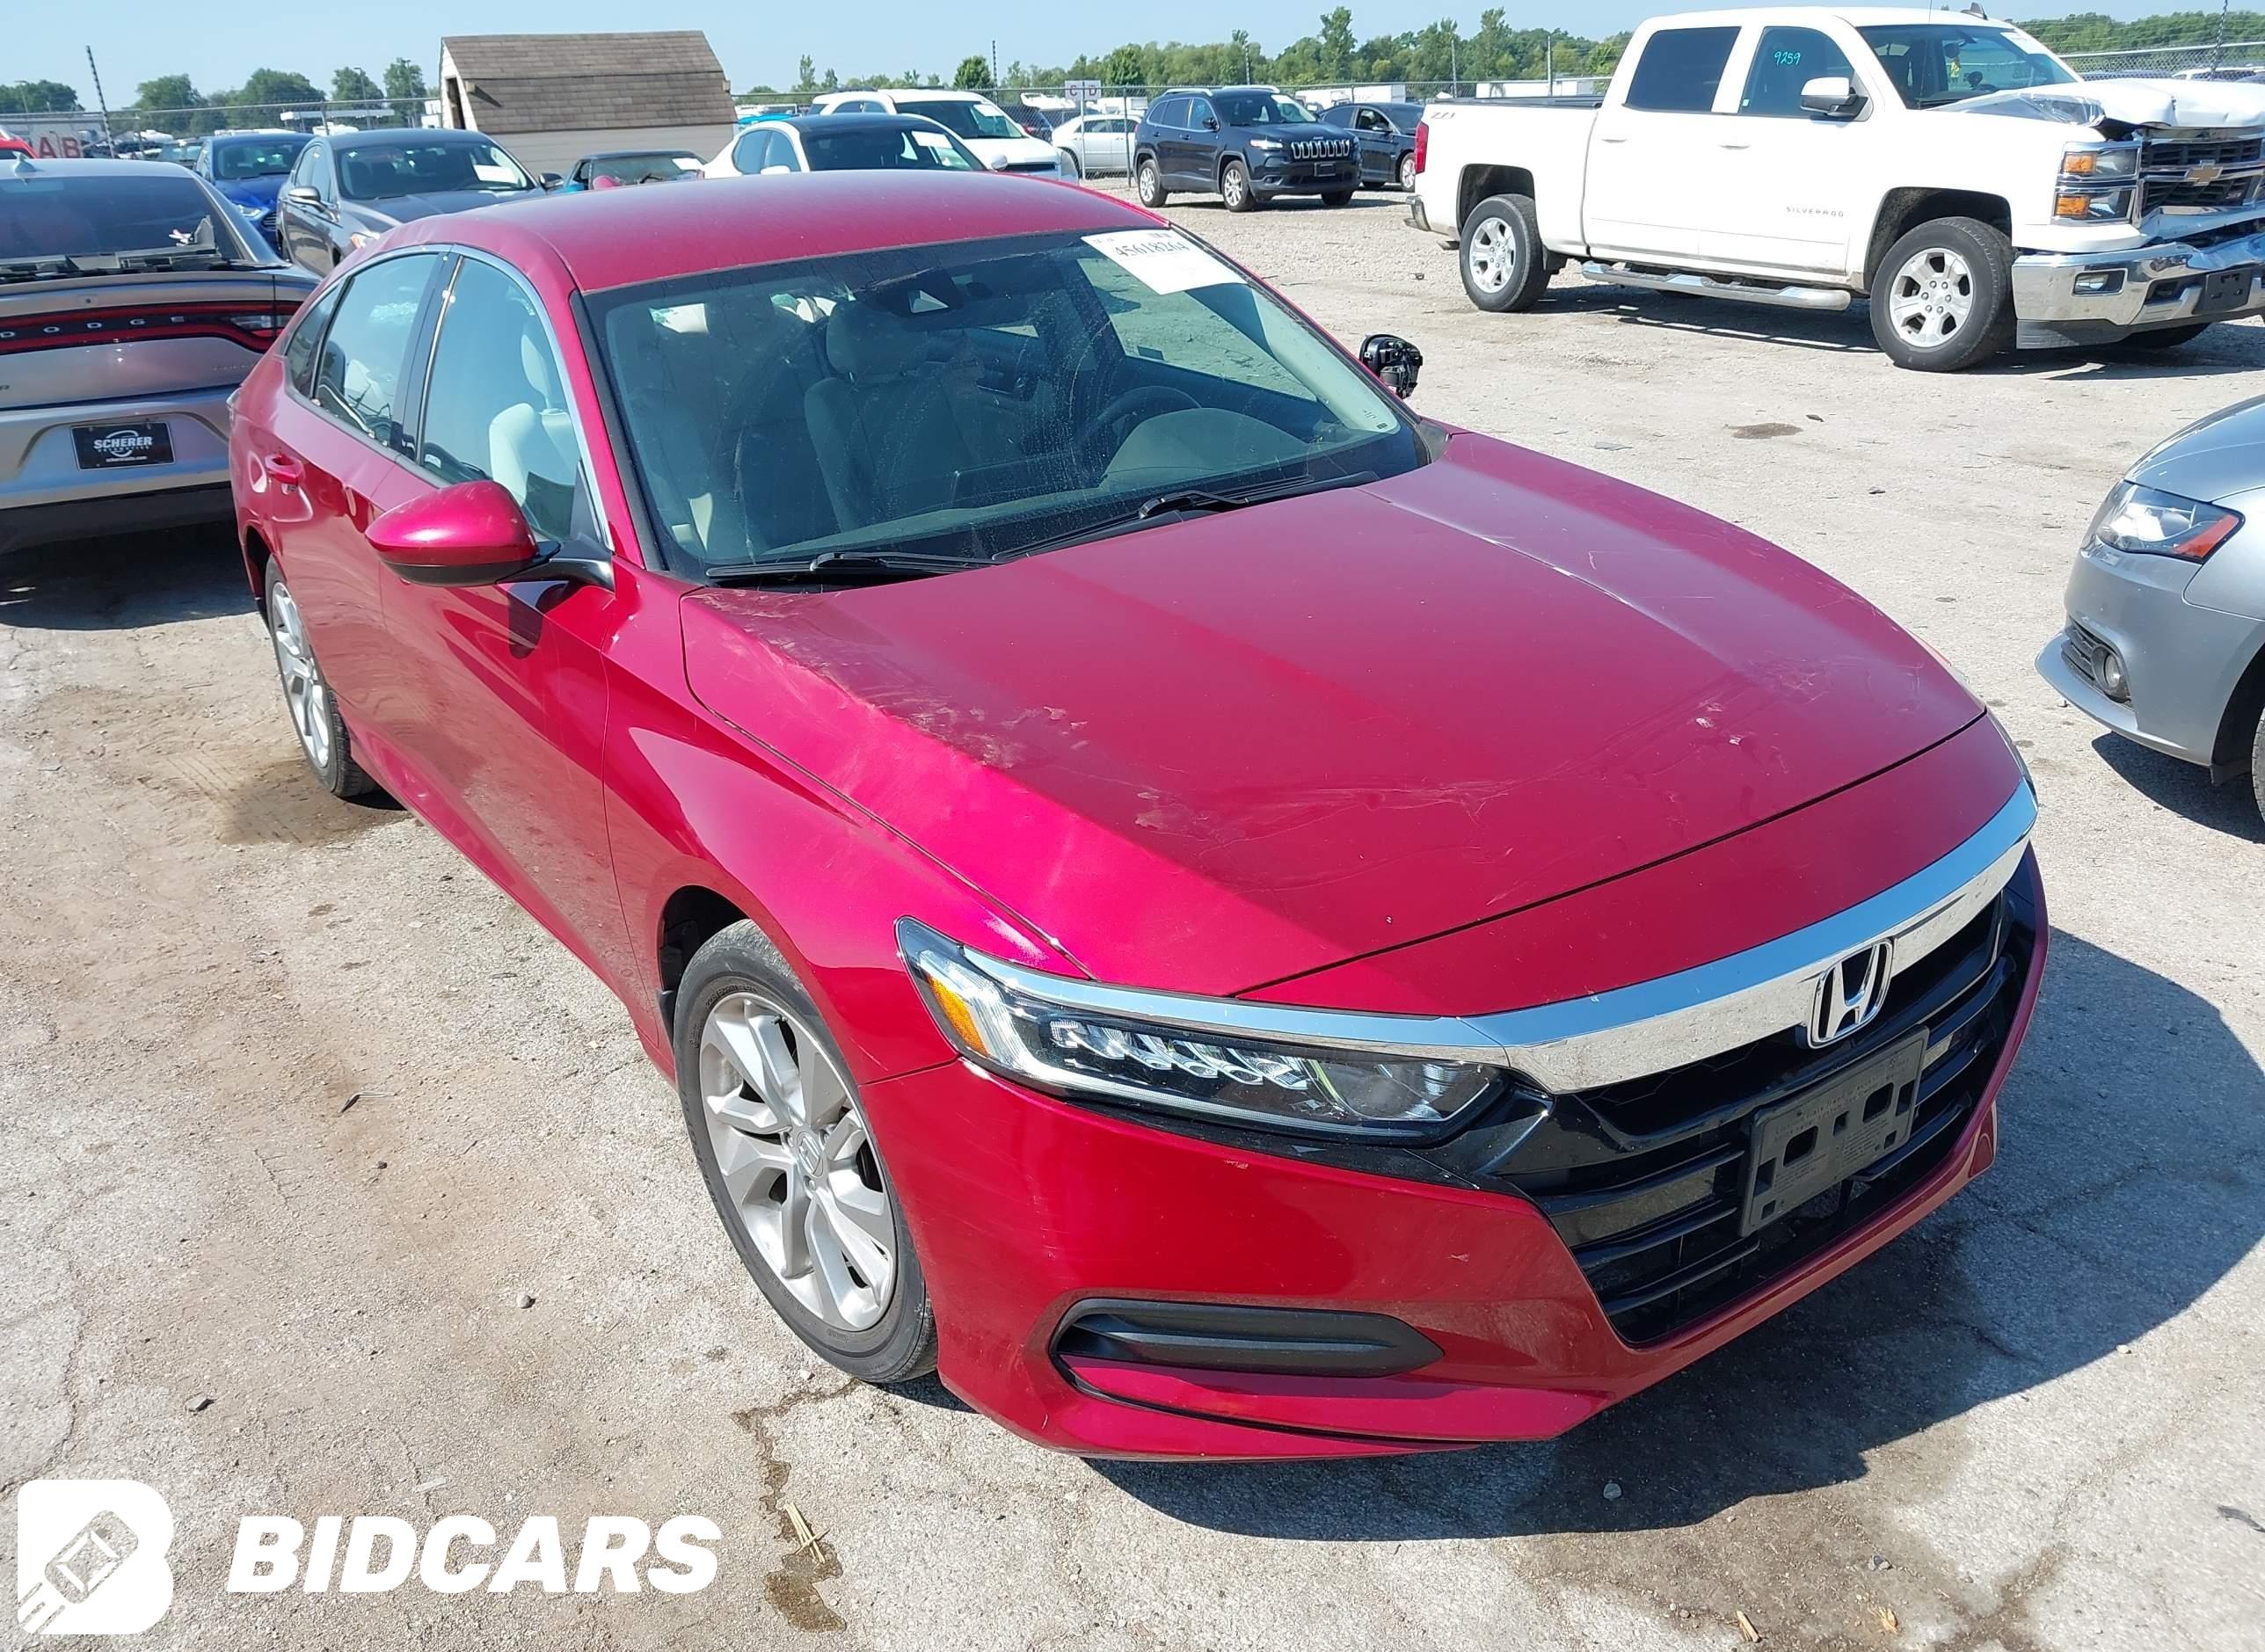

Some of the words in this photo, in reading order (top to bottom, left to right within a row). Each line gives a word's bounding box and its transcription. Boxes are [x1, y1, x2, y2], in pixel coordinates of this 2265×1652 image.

[1773, 51, 1802, 66] 9259
[1069, 84, 1078, 97] C
[1089, 84, 1098, 97] D
[1786, 206, 1845, 218] SILVERADO
[93, 436, 153, 449] SCHERER
